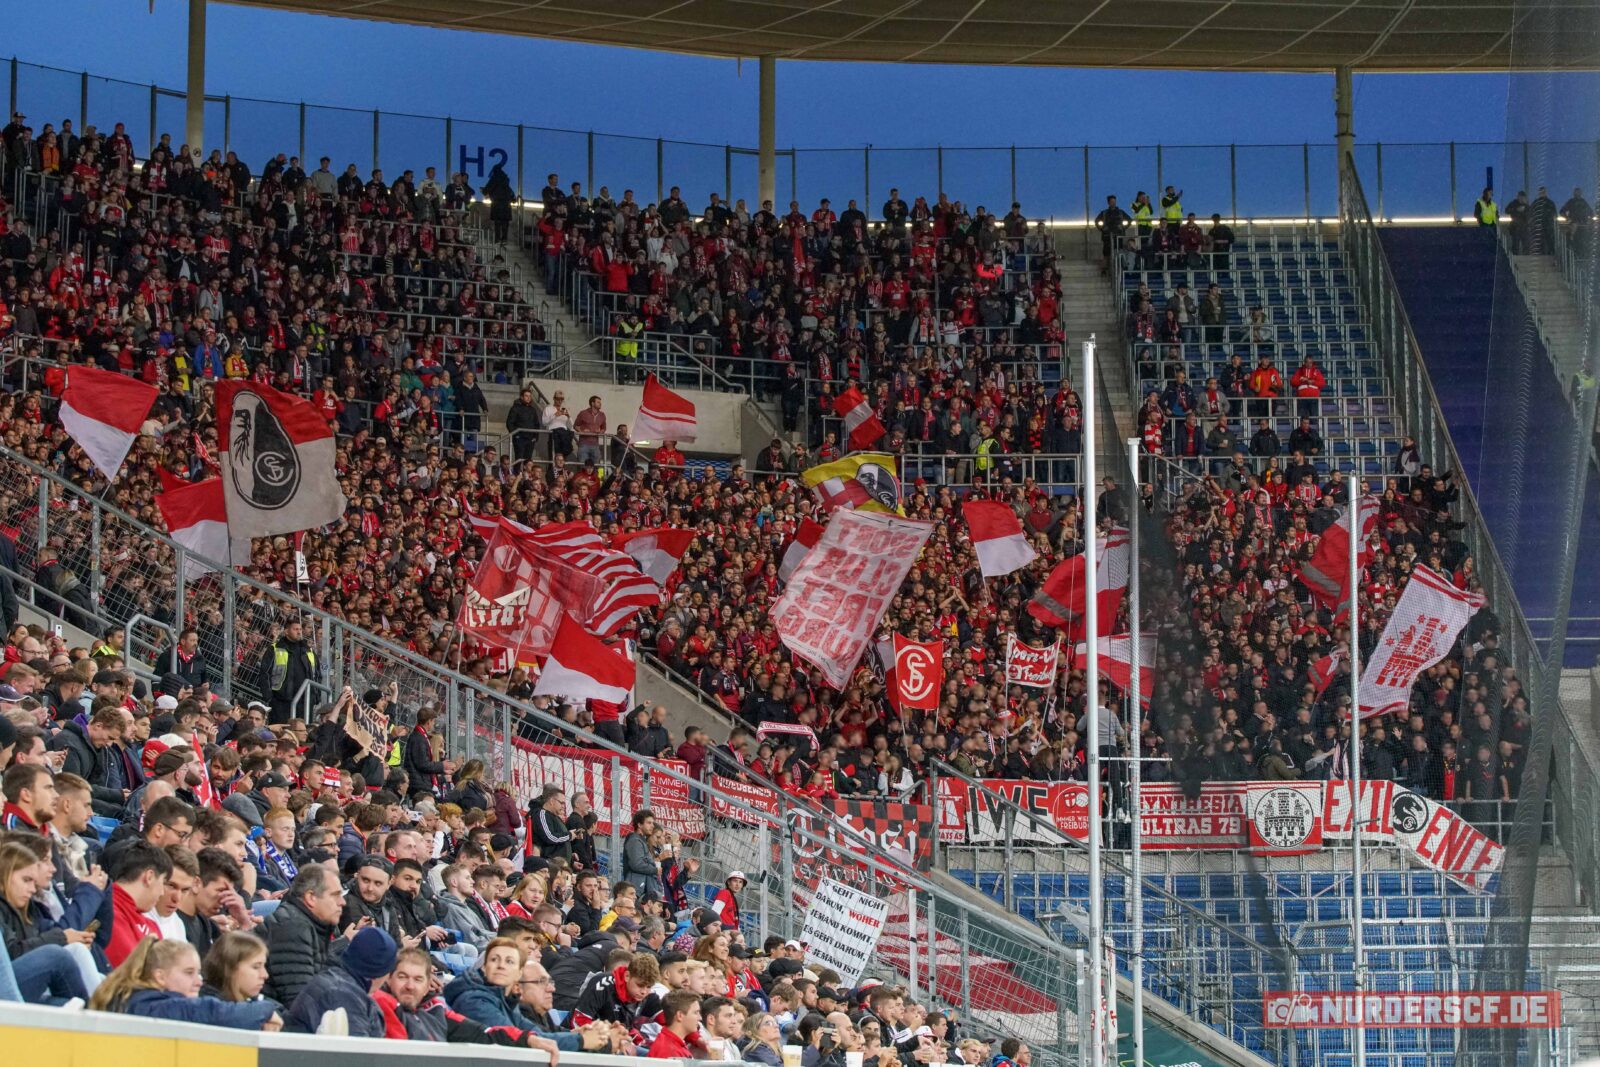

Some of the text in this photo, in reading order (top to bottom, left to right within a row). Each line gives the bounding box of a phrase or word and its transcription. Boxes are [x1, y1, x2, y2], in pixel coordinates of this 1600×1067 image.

[459, 144, 509, 178] H2
[1060, 821, 1089, 830] FREIBUR
[1140, 816, 1240, 835] ULTRAS 79
[832, 885, 855, 899] GEHT
[859, 897, 885, 911] NICHT
[810, 909, 873, 945] JEMAND KOMMT,
[848, 910, 880, 928] WOHER
[803, 925, 866, 961] ES GEHT DARUM,
[812, 948, 843, 968] JEMAND
[843, 966, 860, 977] IST!
